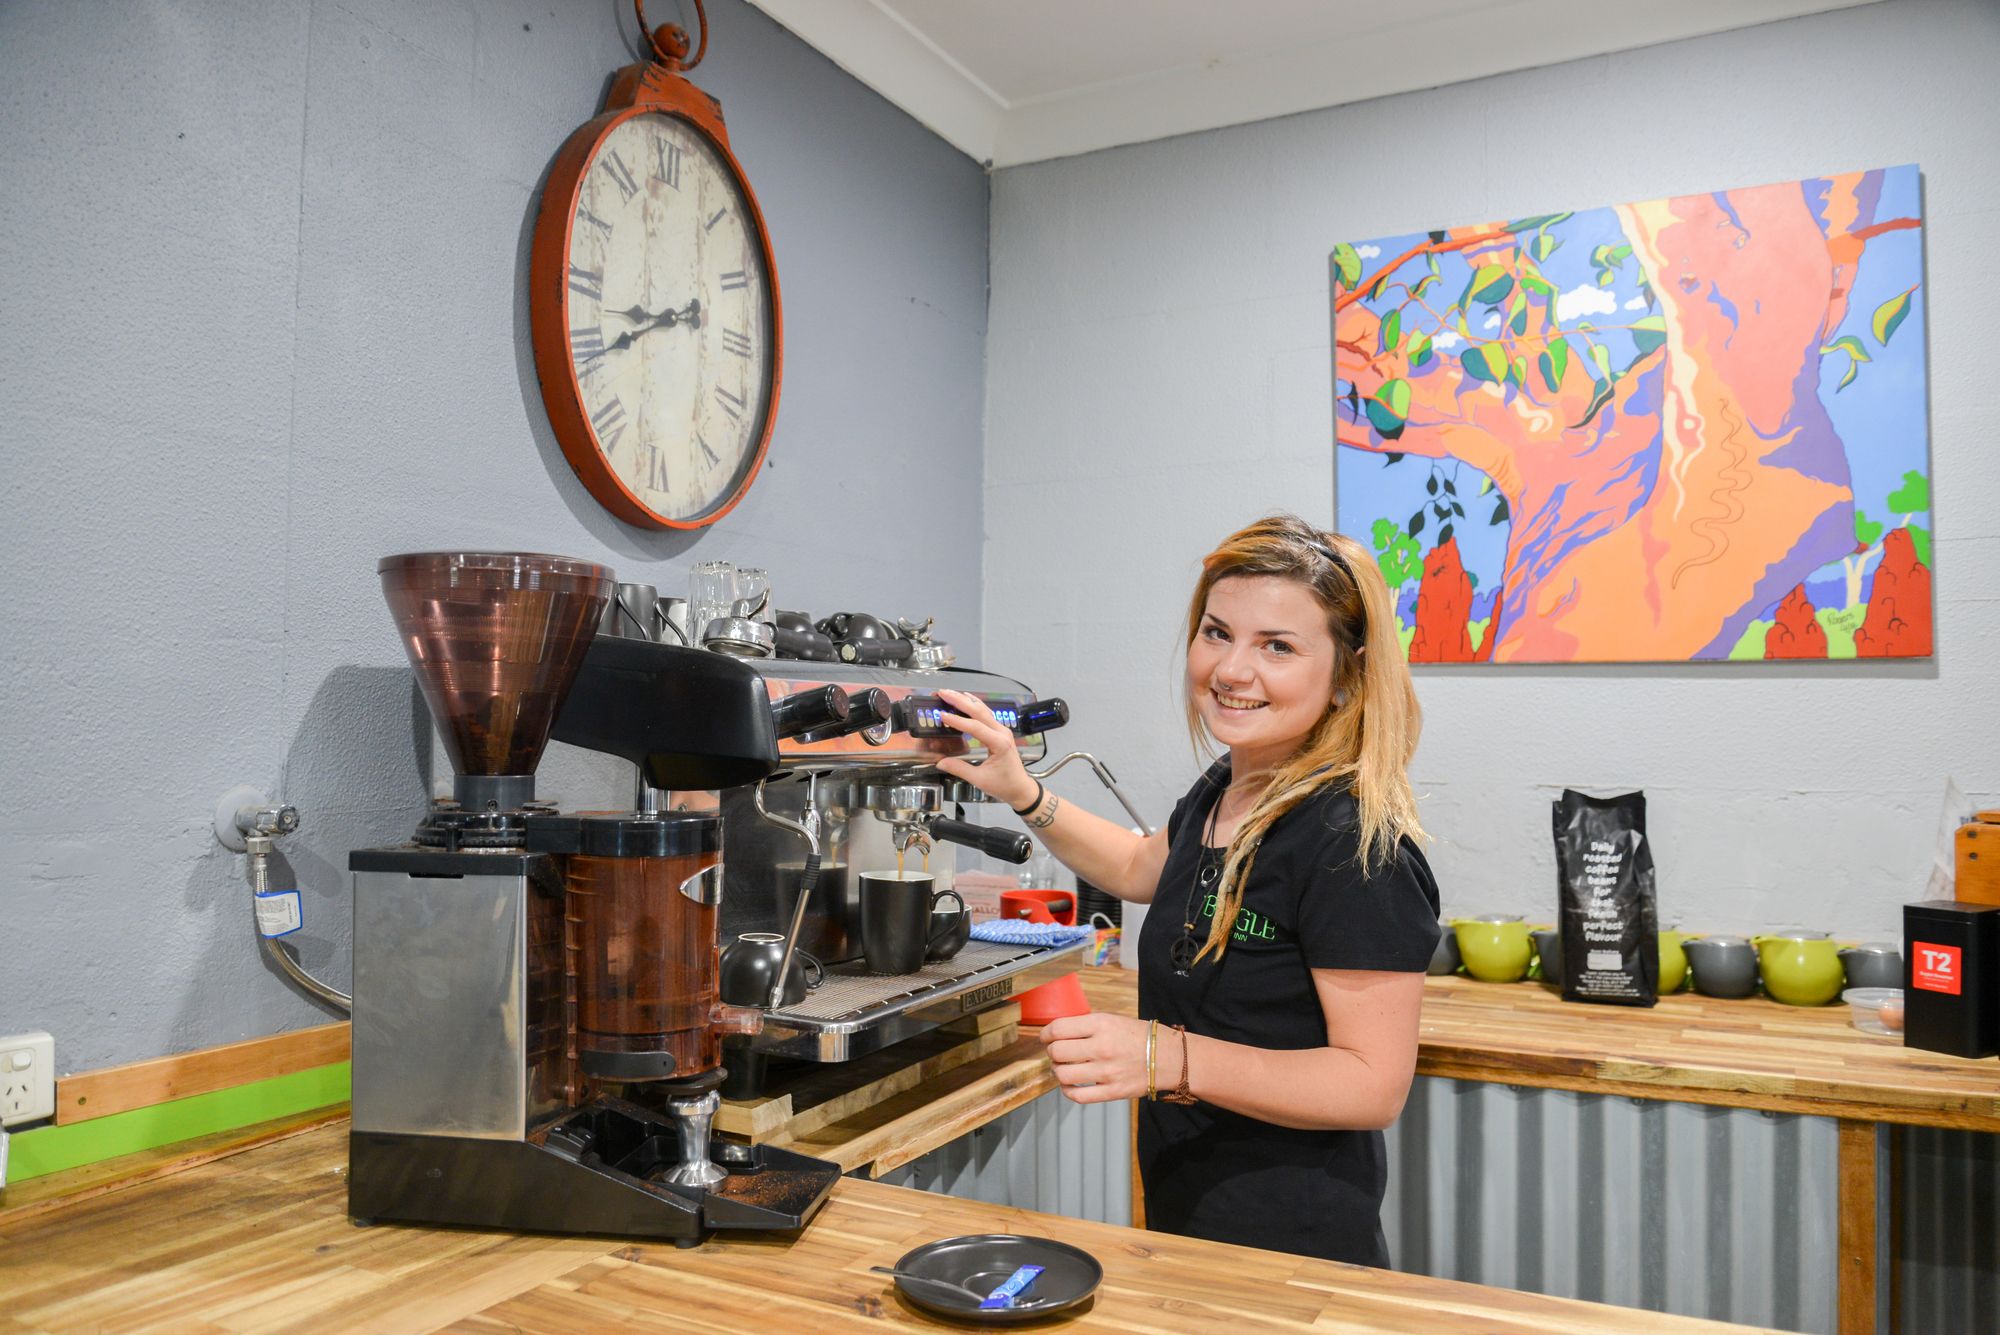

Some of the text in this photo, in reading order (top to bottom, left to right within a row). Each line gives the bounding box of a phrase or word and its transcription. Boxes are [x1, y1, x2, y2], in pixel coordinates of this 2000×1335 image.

[600, 148, 641, 208] XI
[652, 136, 681, 193] XII
[576, 198, 614, 243] X
[703, 206, 728, 236] I
[569, 261, 603, 302] IX
[720, 271, 749, 292] II
[722, 327, 752, 360] III
[591, 393, 628, 456] VII
[647, 444, 671, 494] VI
[1582, 853, 1623, 864] roasted
[1590, 841, 1615, 855] Daily
[1584, 863, 1619, 876] coffee
[1587, 874, 1617, 885] beans
[1593, 886, 1612, 897] for
[1203, 894, 1276, 940] BGLE
[1582, 920, 1624, 932] perfect
[1584, 931, 1623, 942] flavour
[1921, 949, 1952, 973] T2
[966, 977, 1013, 1008] EXPOBAR
